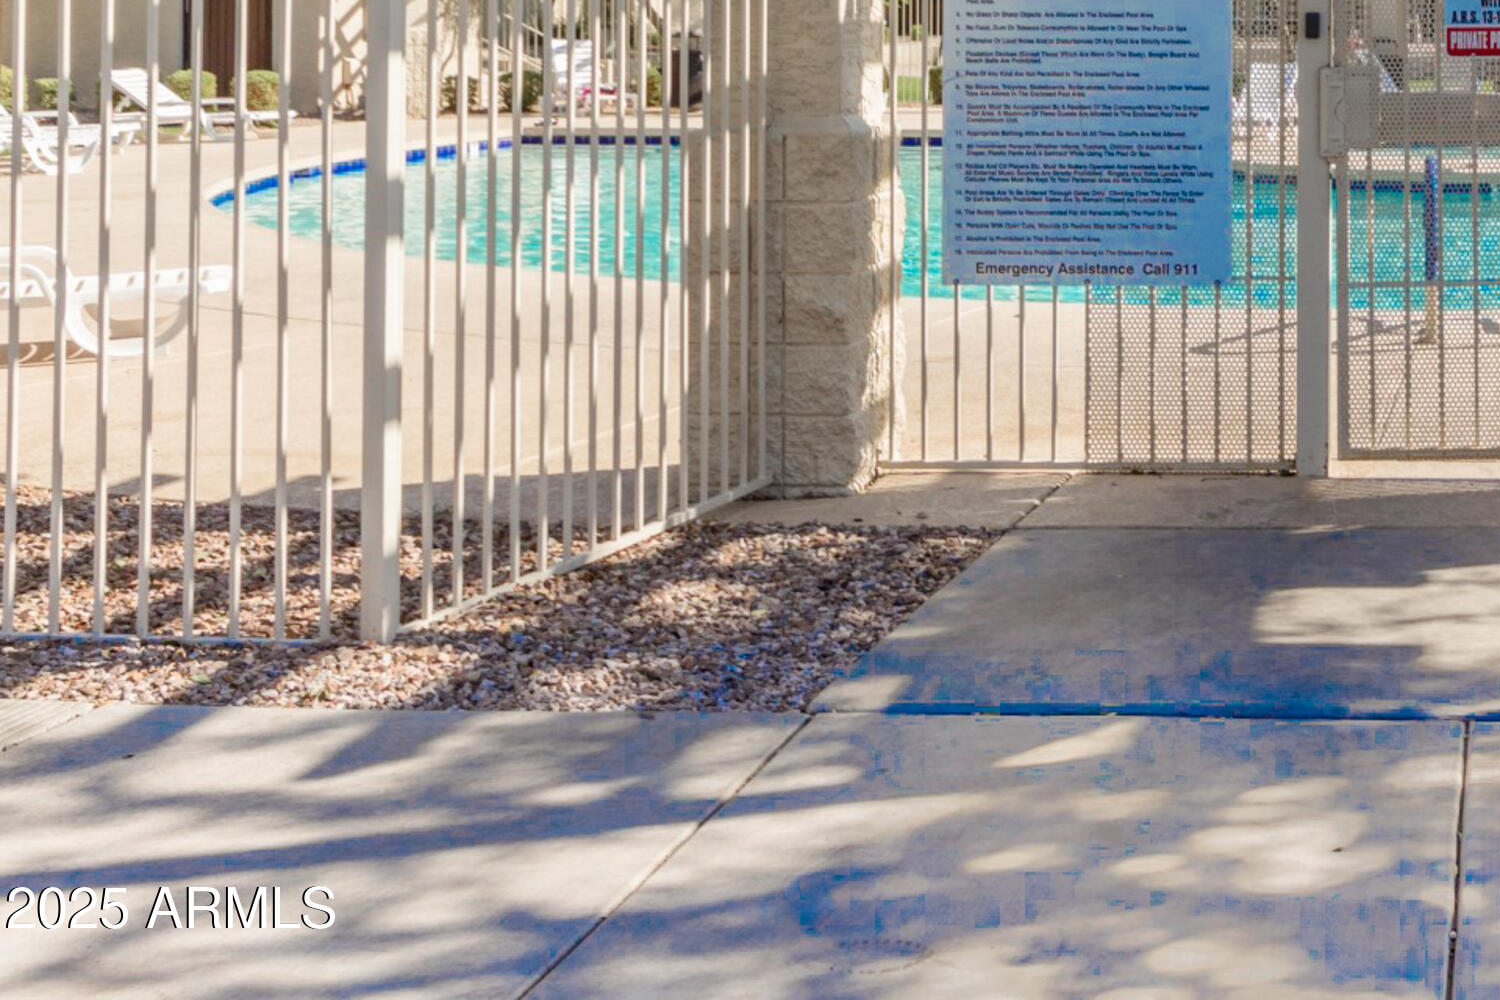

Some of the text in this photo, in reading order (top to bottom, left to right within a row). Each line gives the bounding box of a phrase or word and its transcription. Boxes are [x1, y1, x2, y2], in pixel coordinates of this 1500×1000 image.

[1452, 11, 1479, 24] A.R.S.
[1451, 31, 1488, 49] PRIVATE
[975, 262, 1198, 277] Emergency Assistance Call 911
